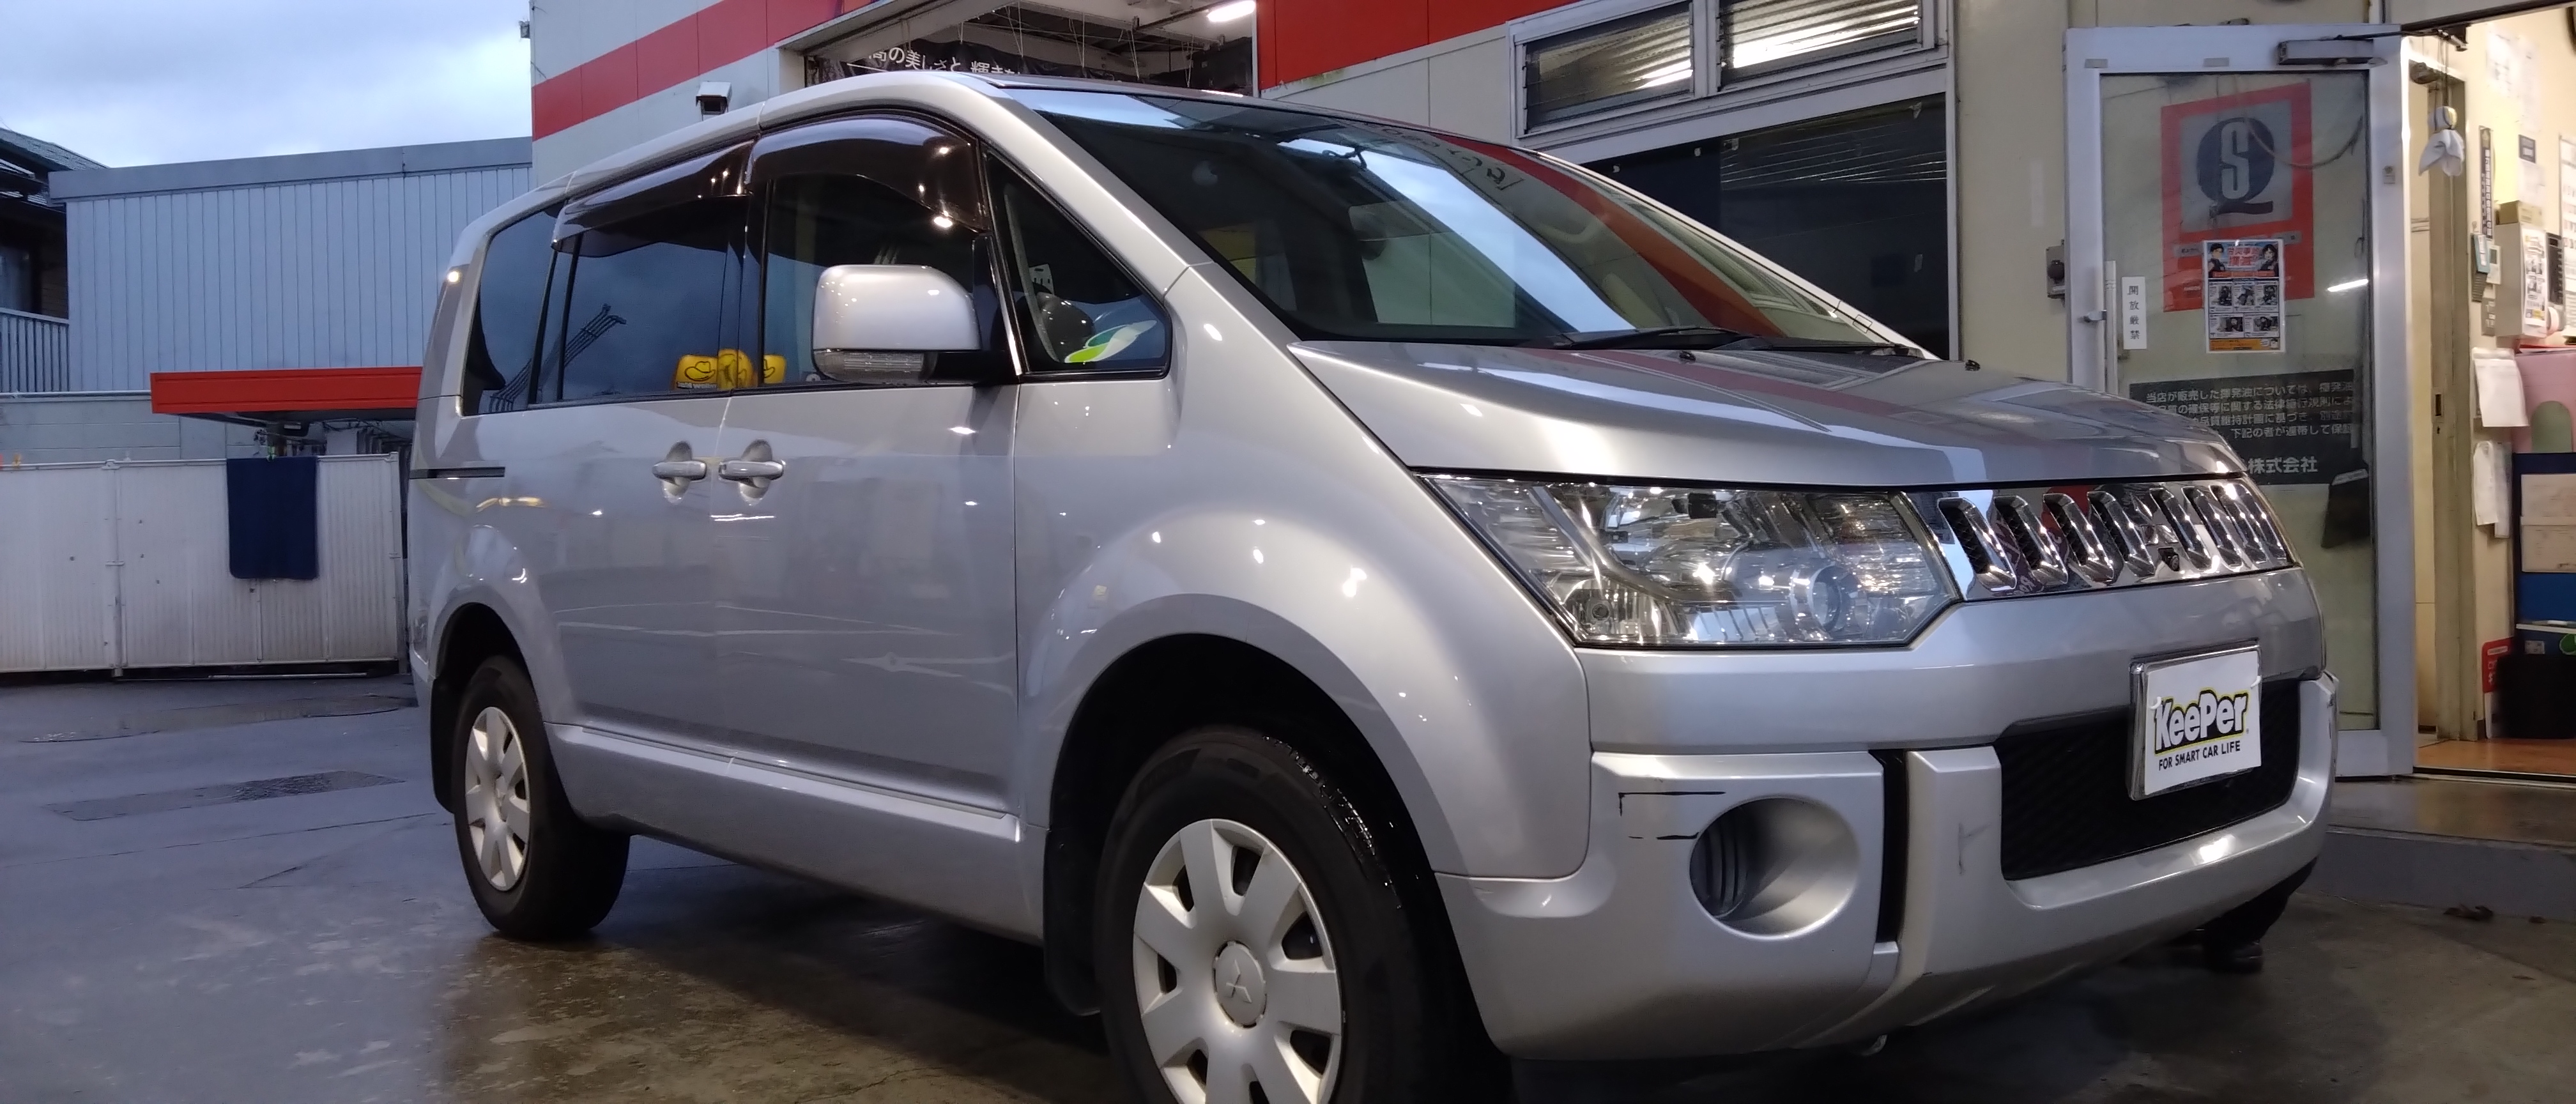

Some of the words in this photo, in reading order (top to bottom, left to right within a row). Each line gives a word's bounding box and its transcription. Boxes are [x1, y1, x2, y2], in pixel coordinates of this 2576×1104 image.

[2127, 285, 2140, 339] 開放厳禁
[2248, 456, 2319, 474] 株式会社
[2155, 690, 2248, 753] KeePer
[2159, 756, 2172, 770] FOR
[2175, 749, 2200, 766] SMART
[2202, 746, 2218, 758] CAR
[2221, 740, 2241, 755] LIFE
